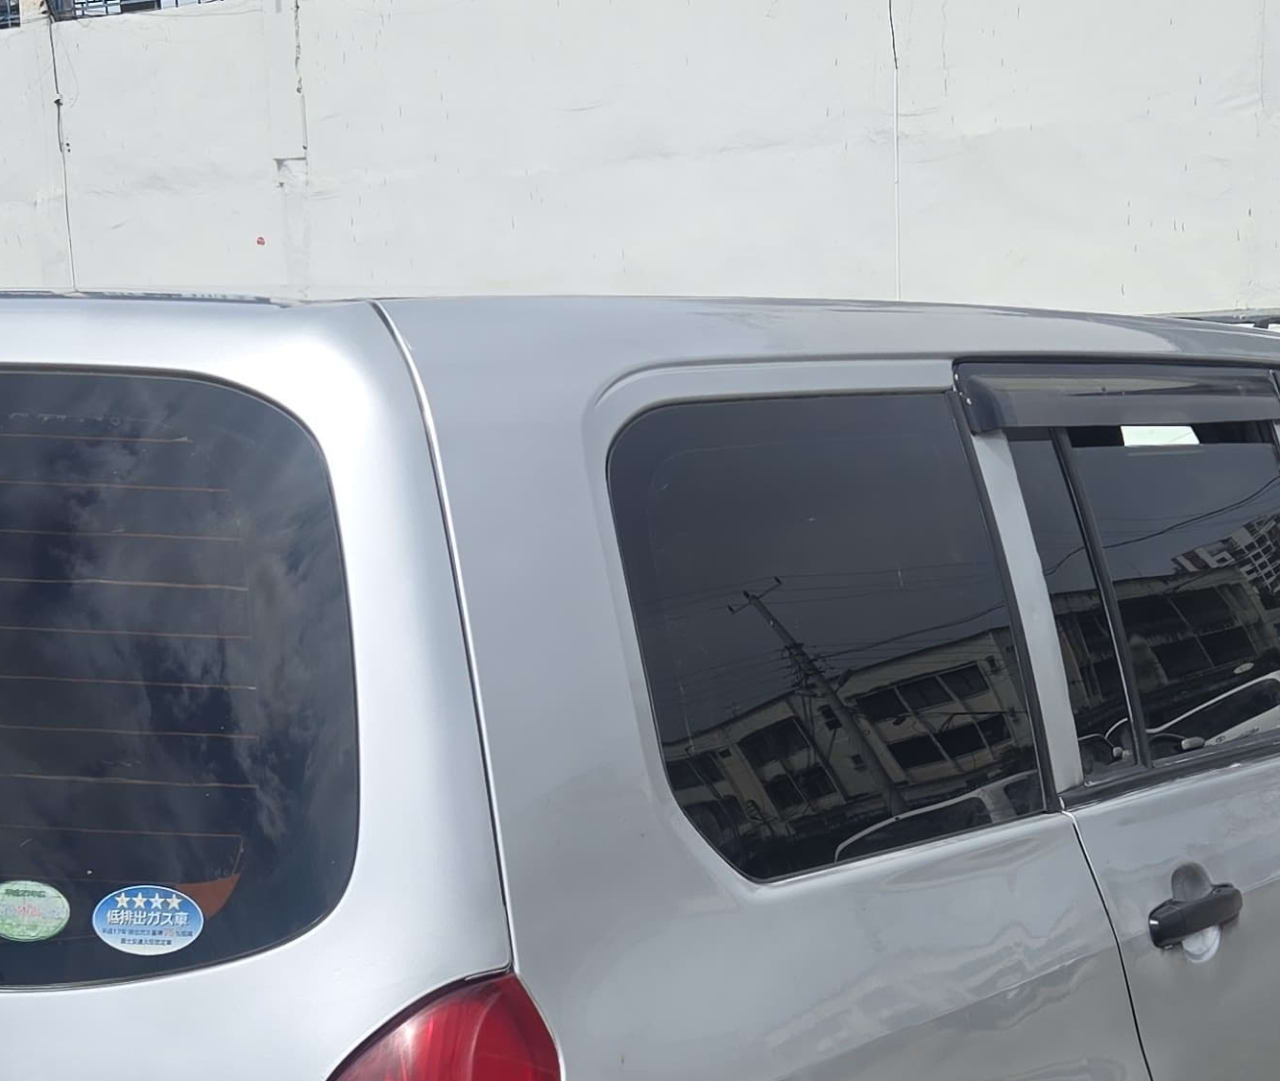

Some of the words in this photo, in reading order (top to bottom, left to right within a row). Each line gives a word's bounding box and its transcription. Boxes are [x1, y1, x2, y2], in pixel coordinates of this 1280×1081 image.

[106, 909, 189, 927] 低排出ガス車
